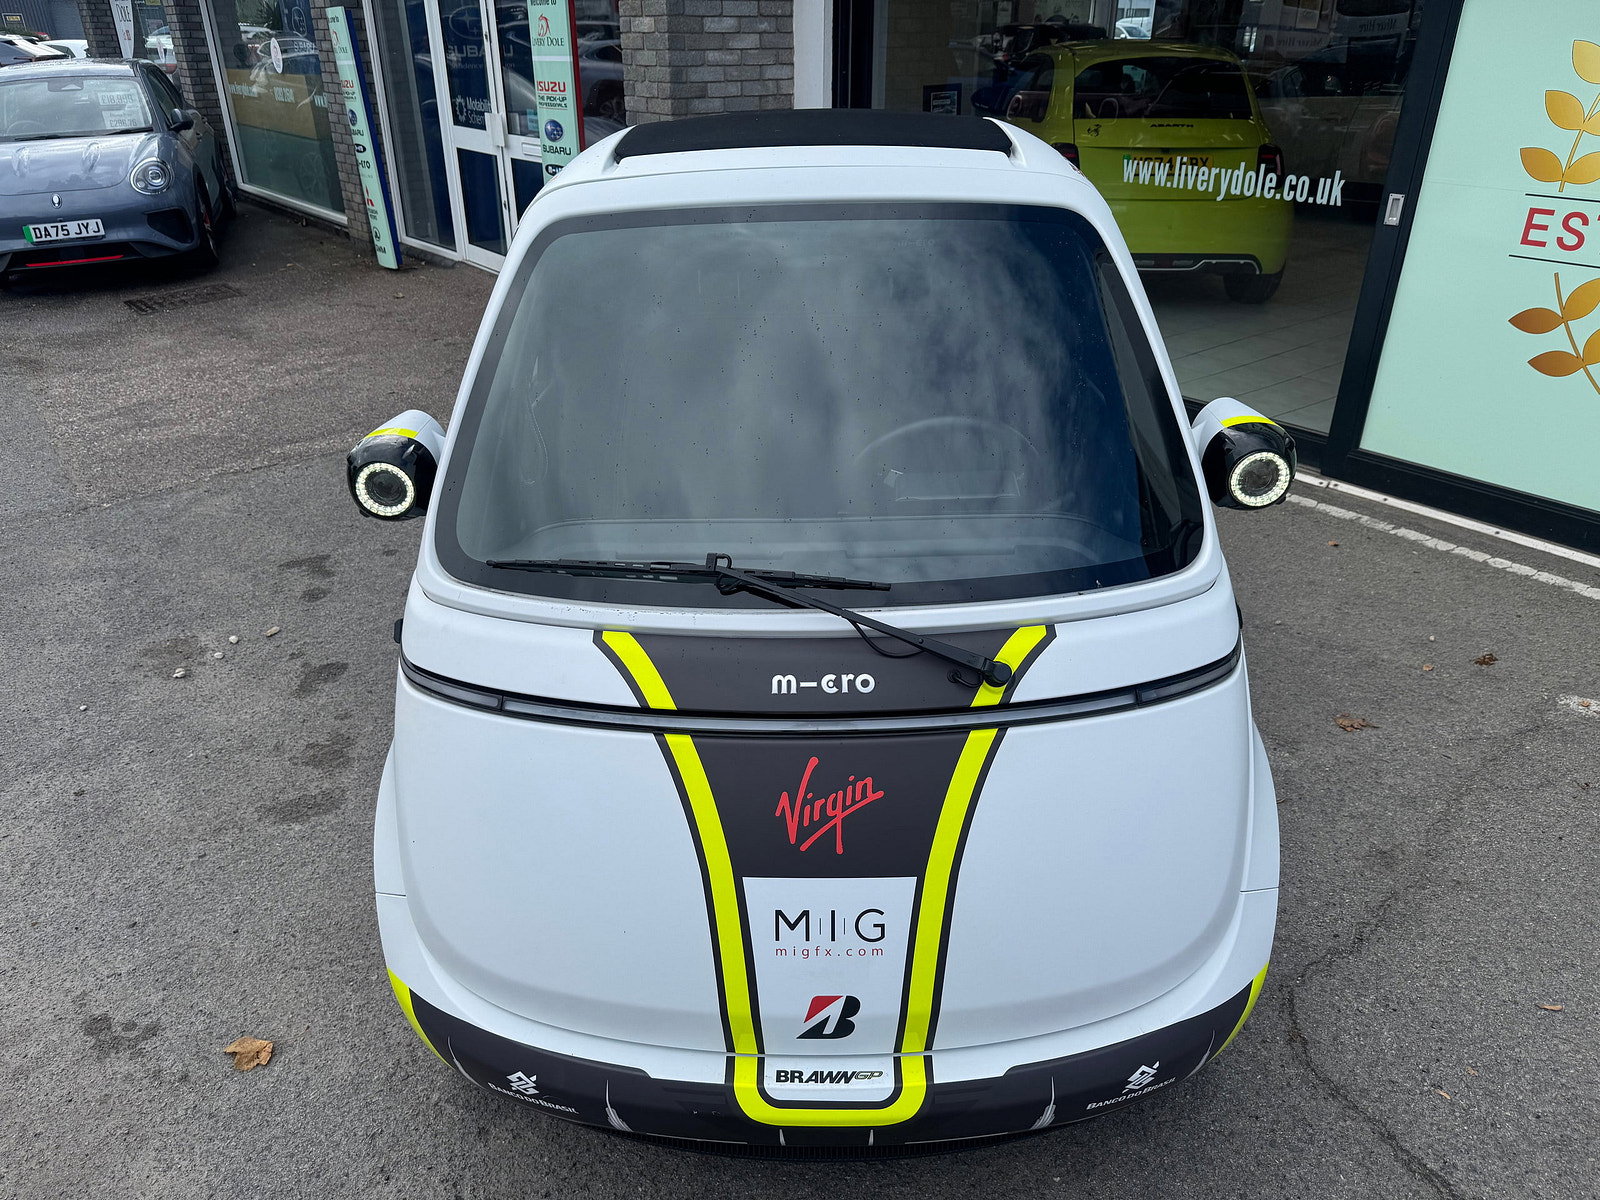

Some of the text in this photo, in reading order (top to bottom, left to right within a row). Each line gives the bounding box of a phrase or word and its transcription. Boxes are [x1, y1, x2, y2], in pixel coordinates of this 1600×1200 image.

[546, 36, 565, 47] DOLE
[536, 80, 567, 93] ISUZU
[466, 96, 492, 112] Motabilit
[546, 95, 567, 103] PICK-UP
[542, 144, 572, 156] SUBARU
[1122, 155, 1346, 207] www.liverydole.co.uk
[32, 221, 101, 240] DA75 JYJ
[1520, 207, 1600, 252] ES
[775, 756, 885, 854] Virgin
[775, 946, 884, 959] migfx.com
